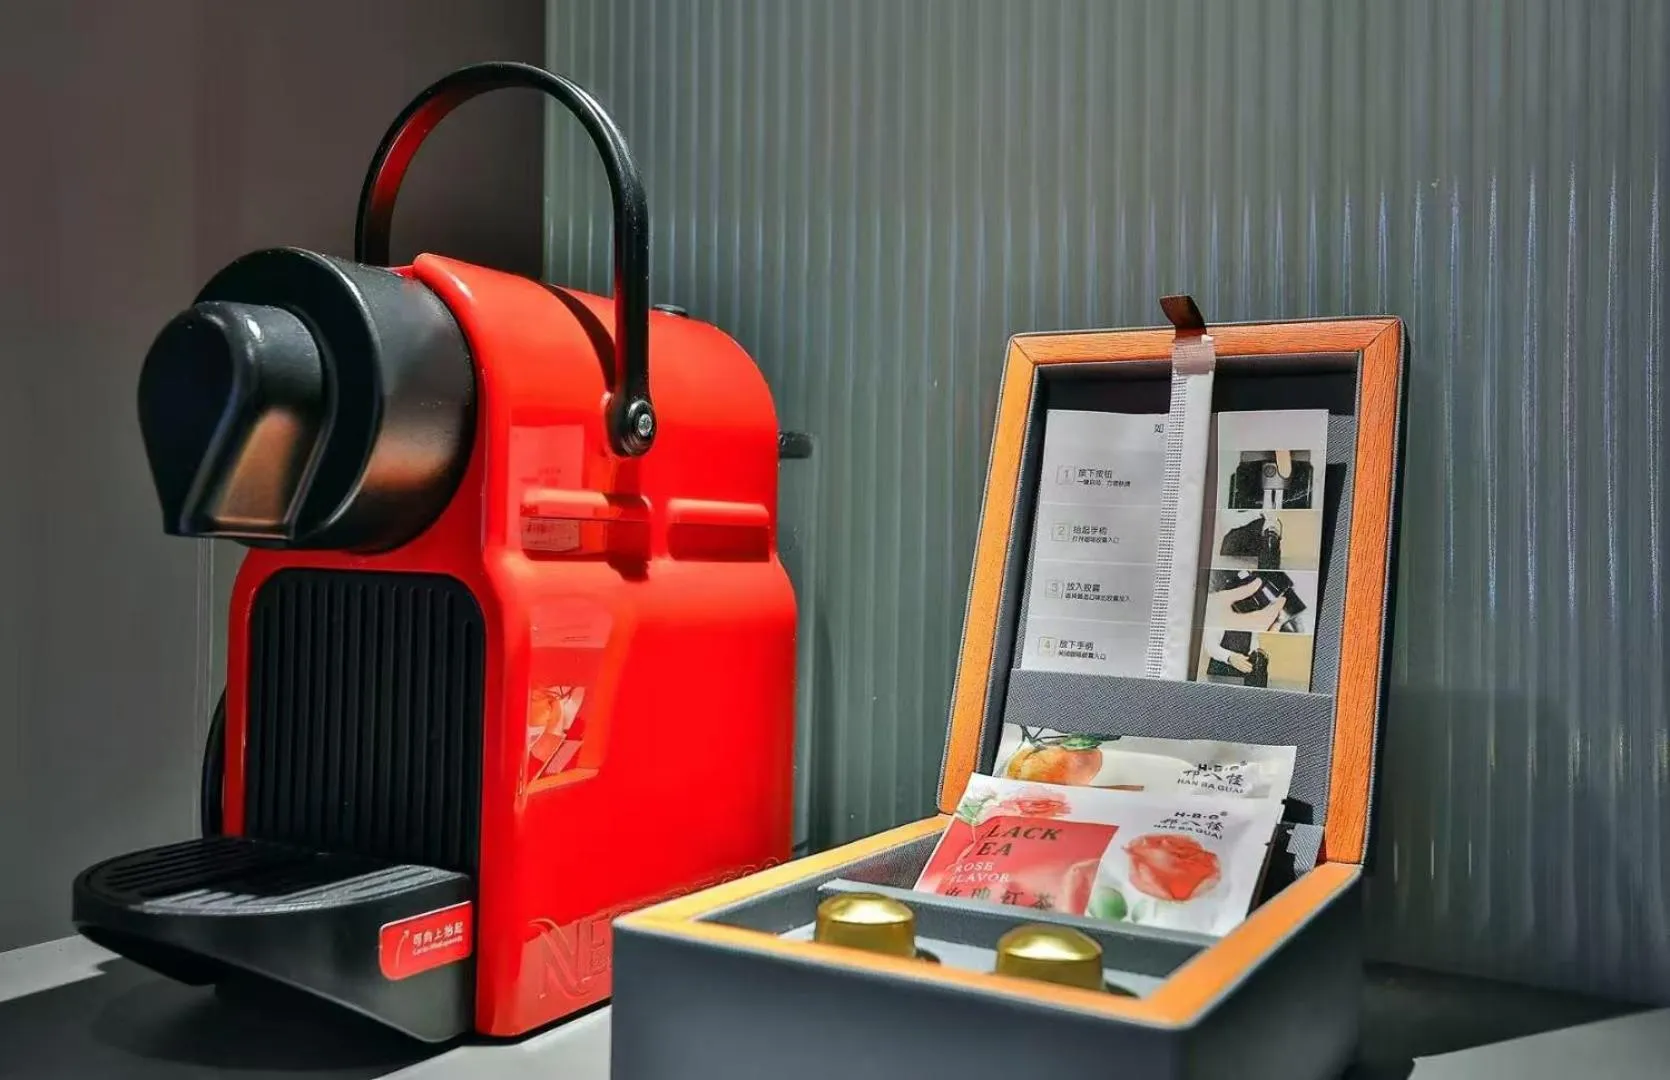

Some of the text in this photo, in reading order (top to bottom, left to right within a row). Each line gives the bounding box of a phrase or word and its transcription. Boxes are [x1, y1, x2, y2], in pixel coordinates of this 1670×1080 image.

[1177, 778, 1199, 787] HAN
[1201, 781, 1216, 790] BA
[981, 824, 1063, 841] LACK
[970, 842, 1013, 857] EA
